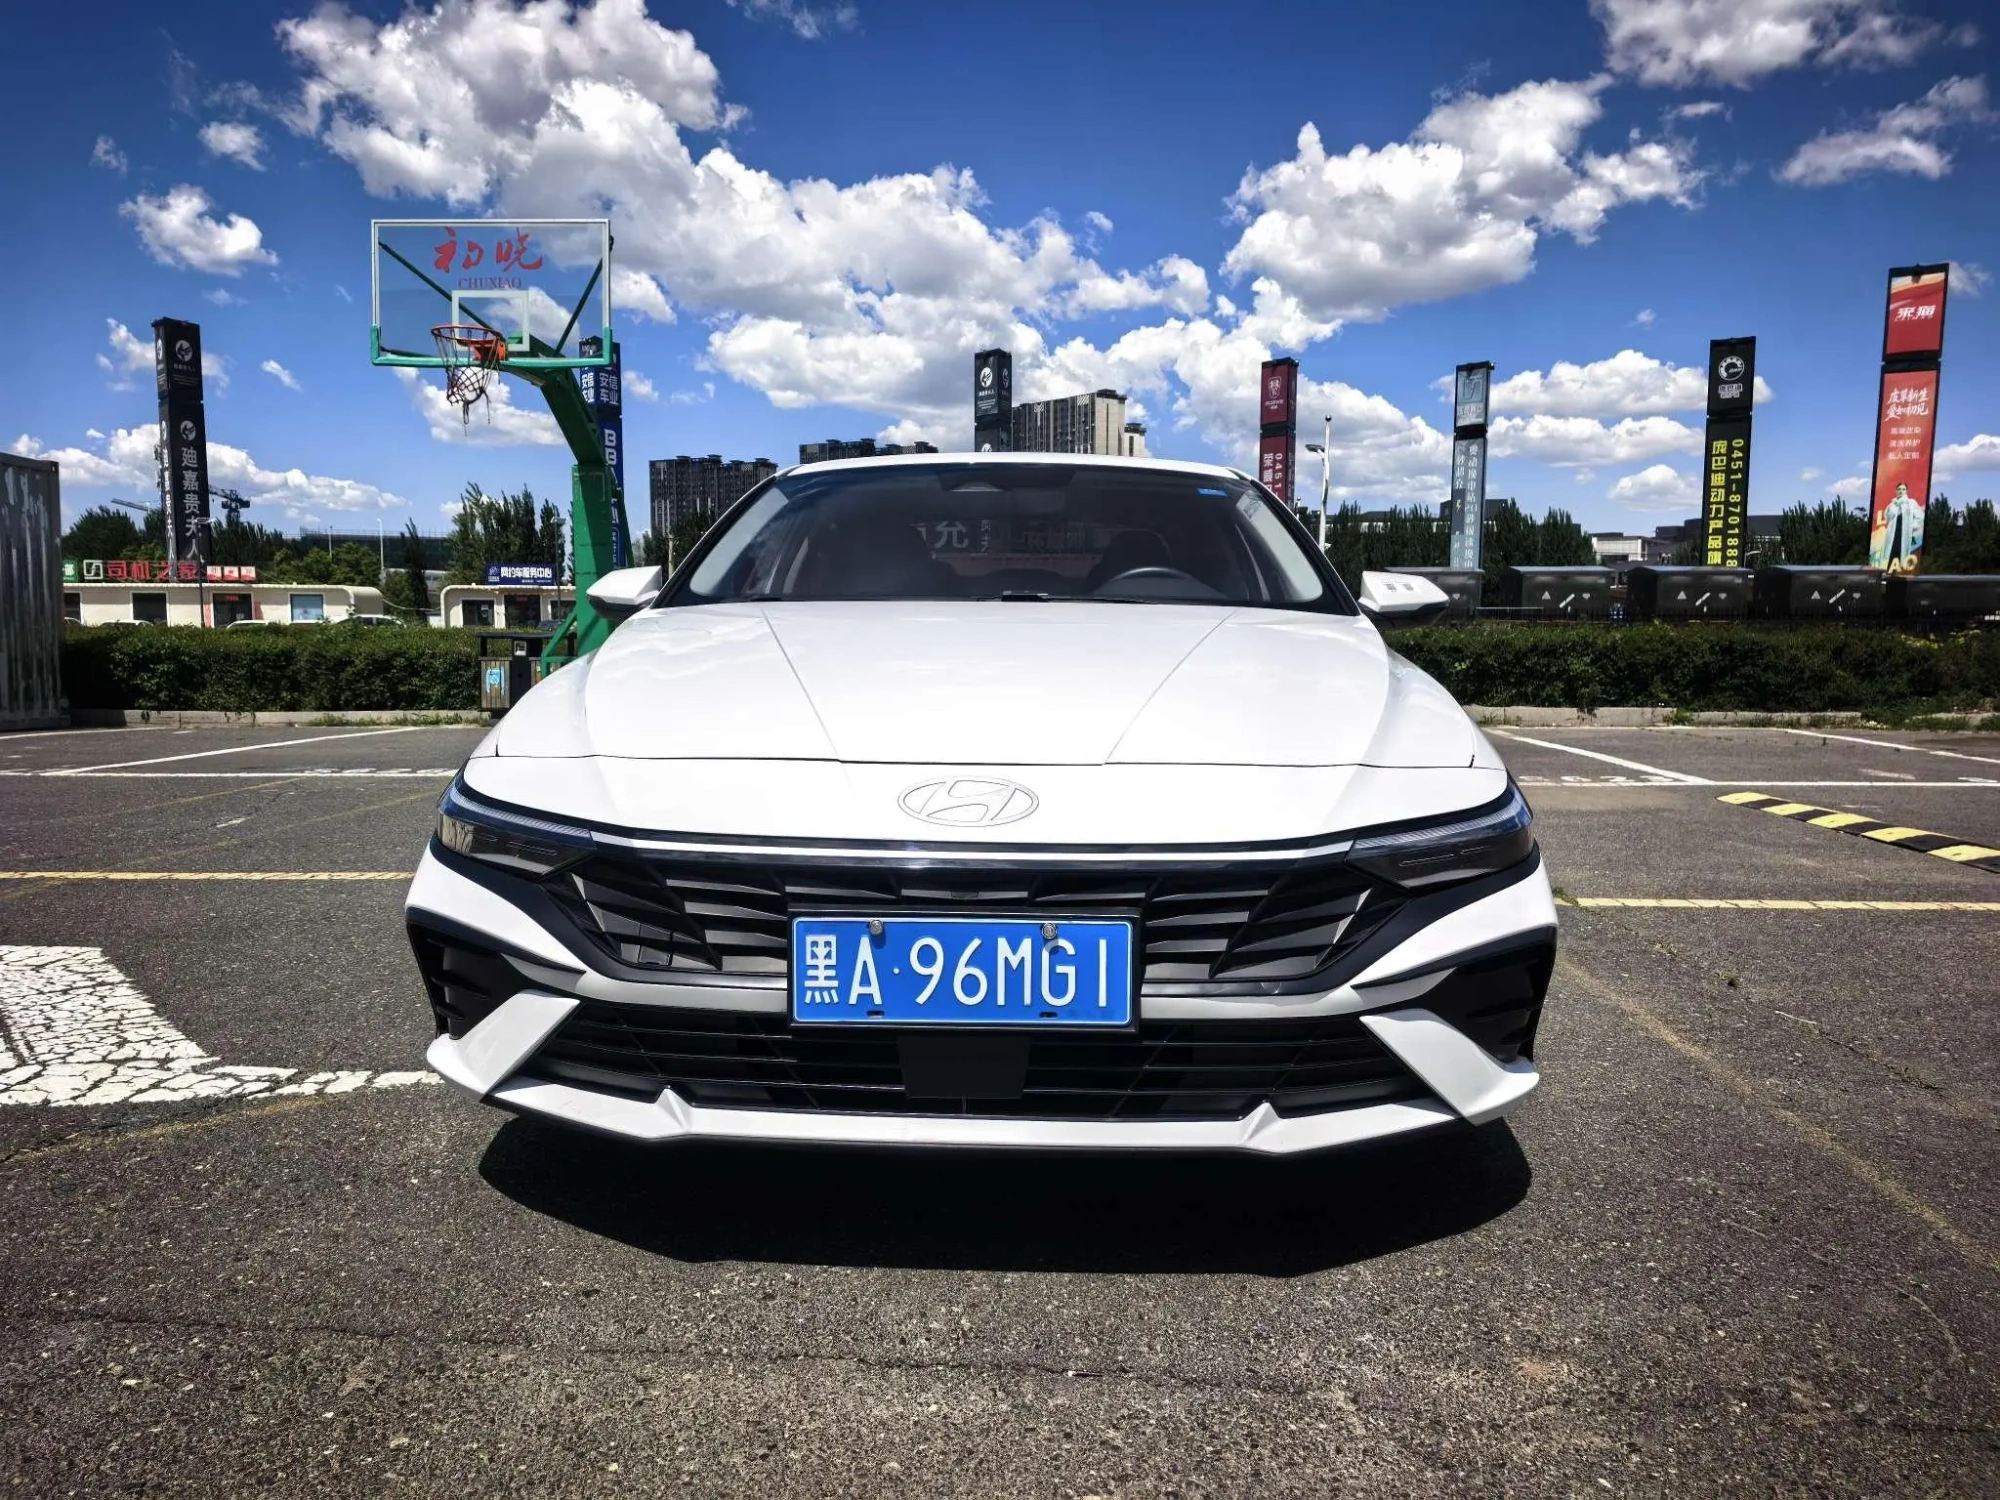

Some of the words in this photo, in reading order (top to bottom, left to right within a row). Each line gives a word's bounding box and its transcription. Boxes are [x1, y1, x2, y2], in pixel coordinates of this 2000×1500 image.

[433, 226, 544, 273] 初晓
[458, 276, 522, 289] CHUXIAO
[106, 559, 198, 580] 司机之家
[501, 567, 552, 579] 网约车服务中心
